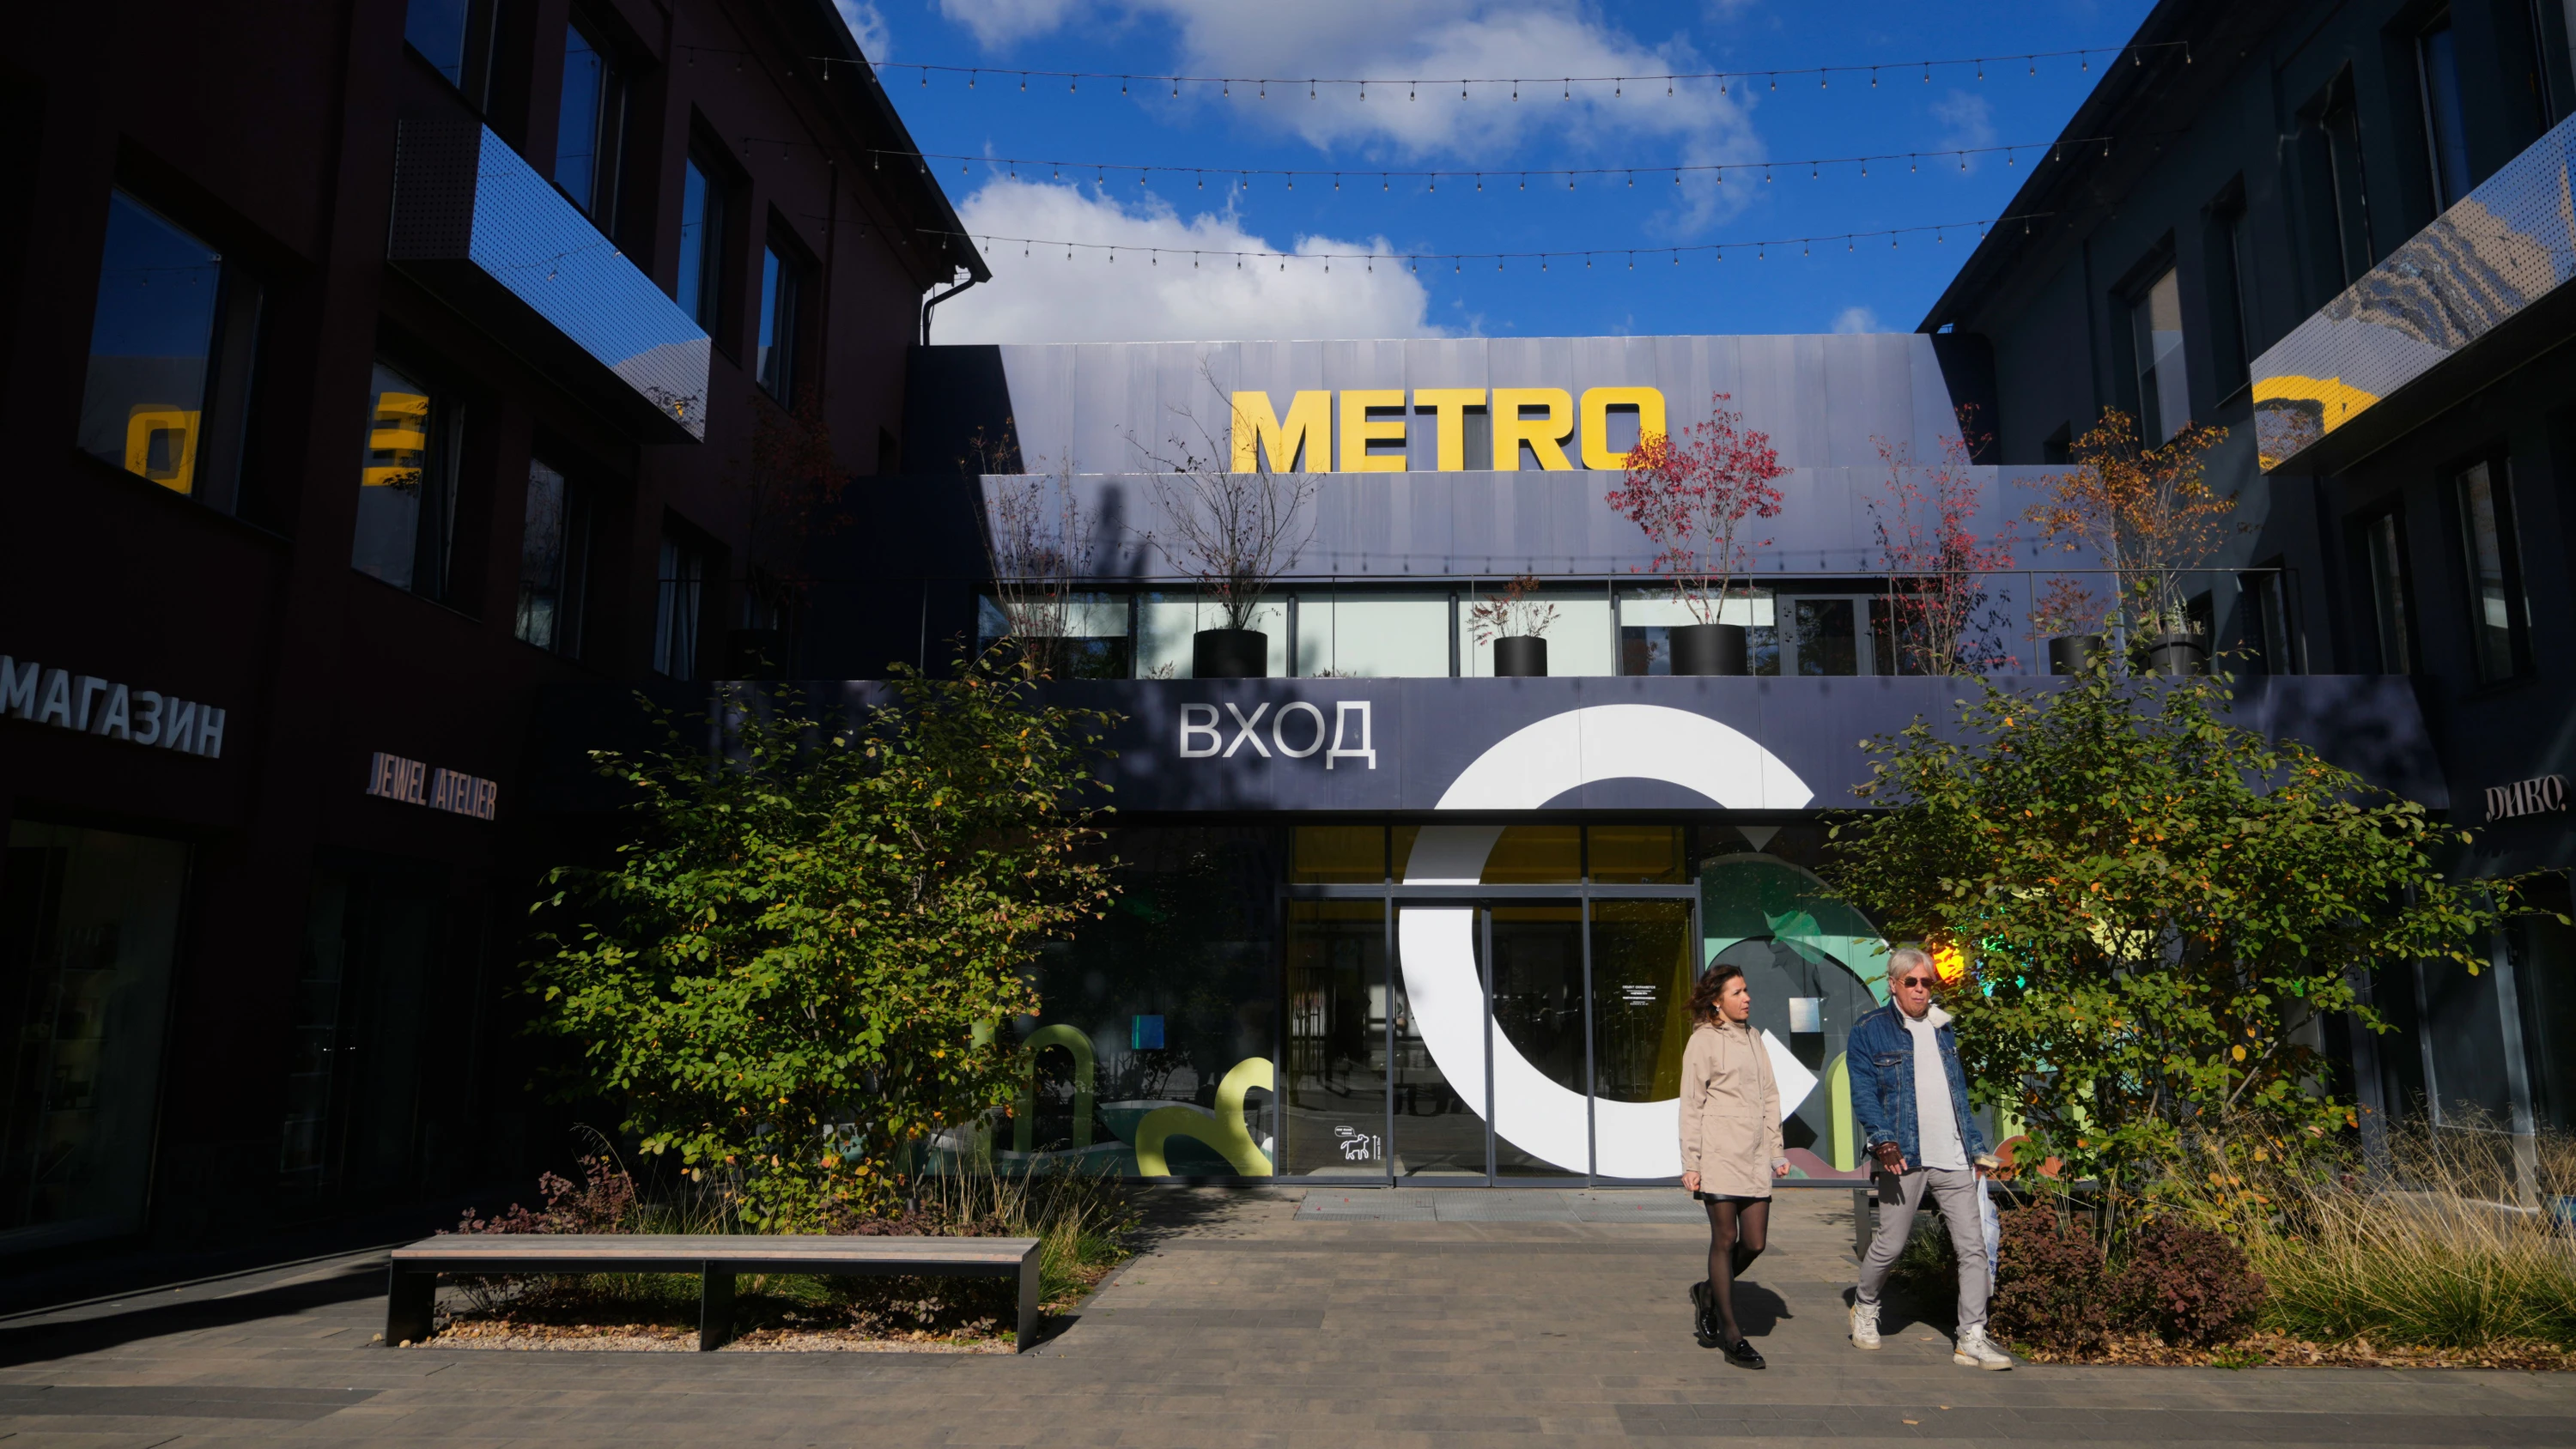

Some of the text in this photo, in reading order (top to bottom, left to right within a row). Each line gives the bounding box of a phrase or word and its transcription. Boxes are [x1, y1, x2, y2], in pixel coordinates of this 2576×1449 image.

[1231, 386, 1666, 472] METRO
[0, 654, 226, 759] МАГАЗИН
[1179, 700, 1376, 769] ВХОД
[366, 751, 497, 822] JEWEL ATELIER
